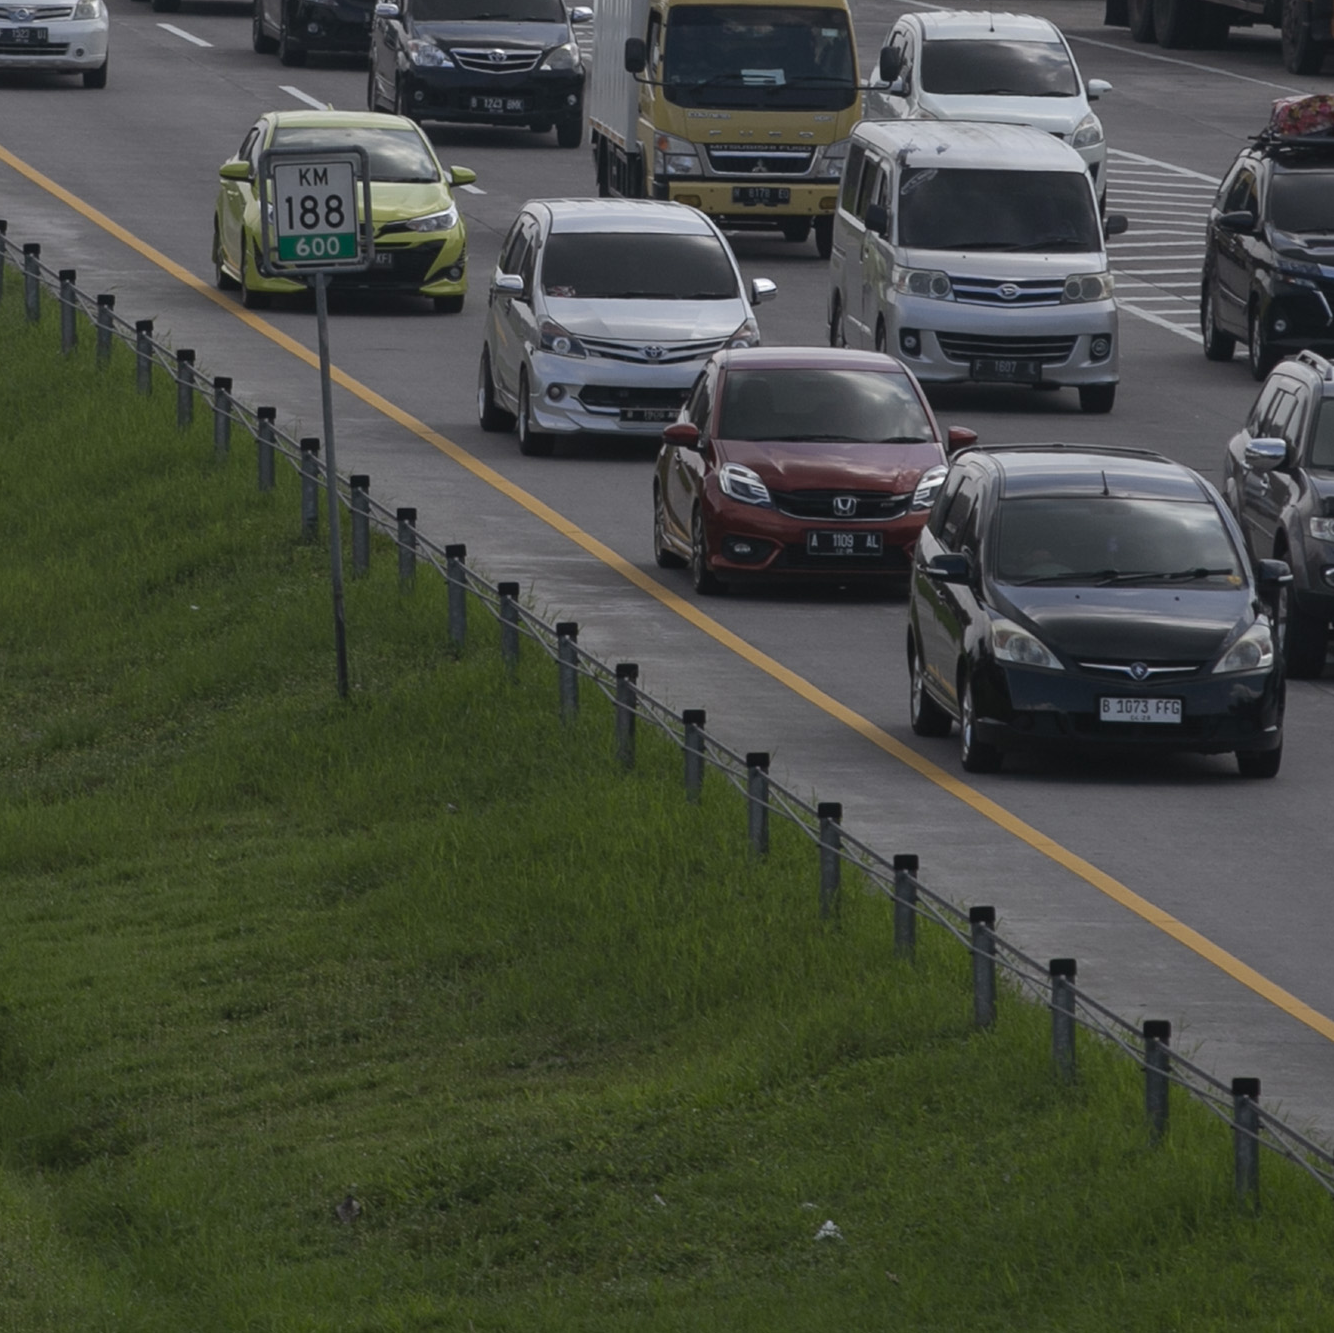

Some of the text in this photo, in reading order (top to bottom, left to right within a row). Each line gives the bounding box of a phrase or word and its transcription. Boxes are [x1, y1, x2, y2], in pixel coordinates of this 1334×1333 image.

[298, 167, 329, 187] KM
[285, 194, 346, 231] 188
[295, 236, 341, 256] 600
[976, 359, 982, 371] F
[995, 360, 1018, 374] 1607
[811, 533, 880, 549] A 1109 AL
[1102, 699, 1180, 715] B 1073 FFG
